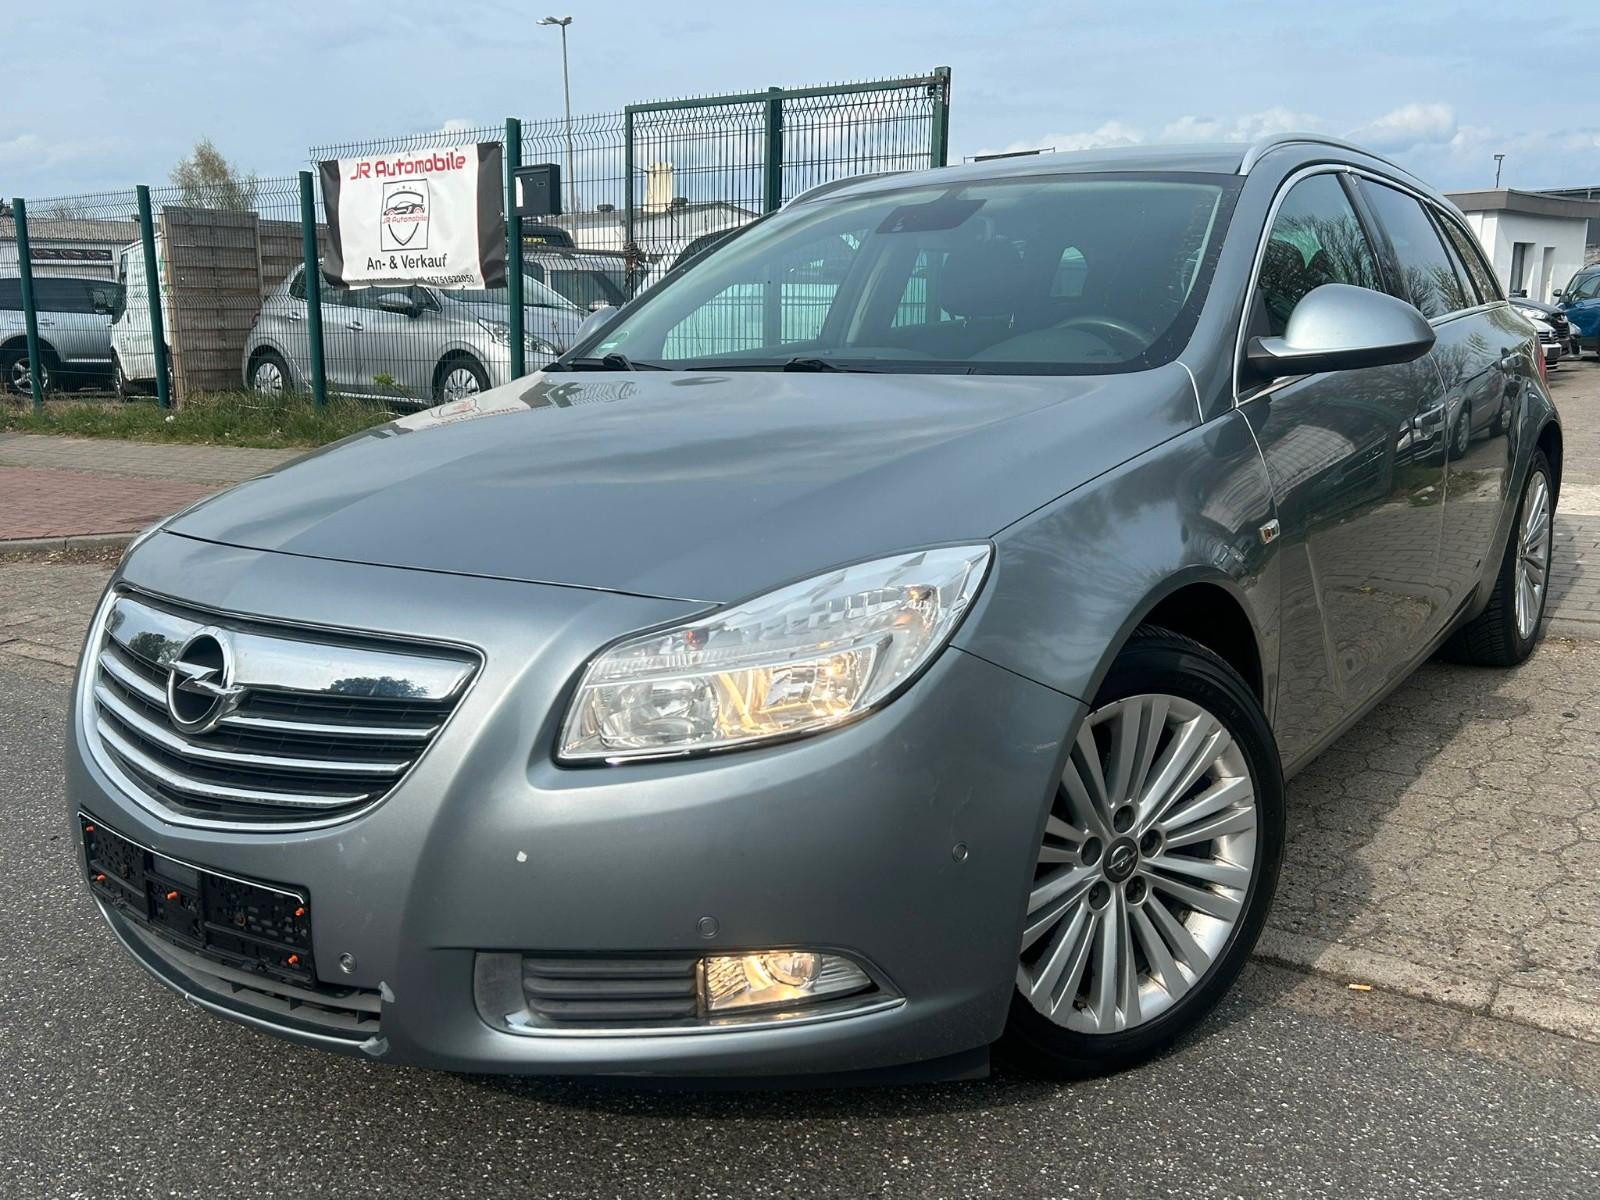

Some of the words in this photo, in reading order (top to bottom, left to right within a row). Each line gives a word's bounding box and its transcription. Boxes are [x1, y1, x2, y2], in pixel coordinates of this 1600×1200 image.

[350, 161, 371, 180] JR
[375, 152, 466, 177] Automobile
[383, 216, 391, 224] JR
[392, 214, 428, 224] Automobile
[367, 256, 386, 271] An-
[389, 255, 398, 270] &
[400, 253, 448, 270] Verkauf
